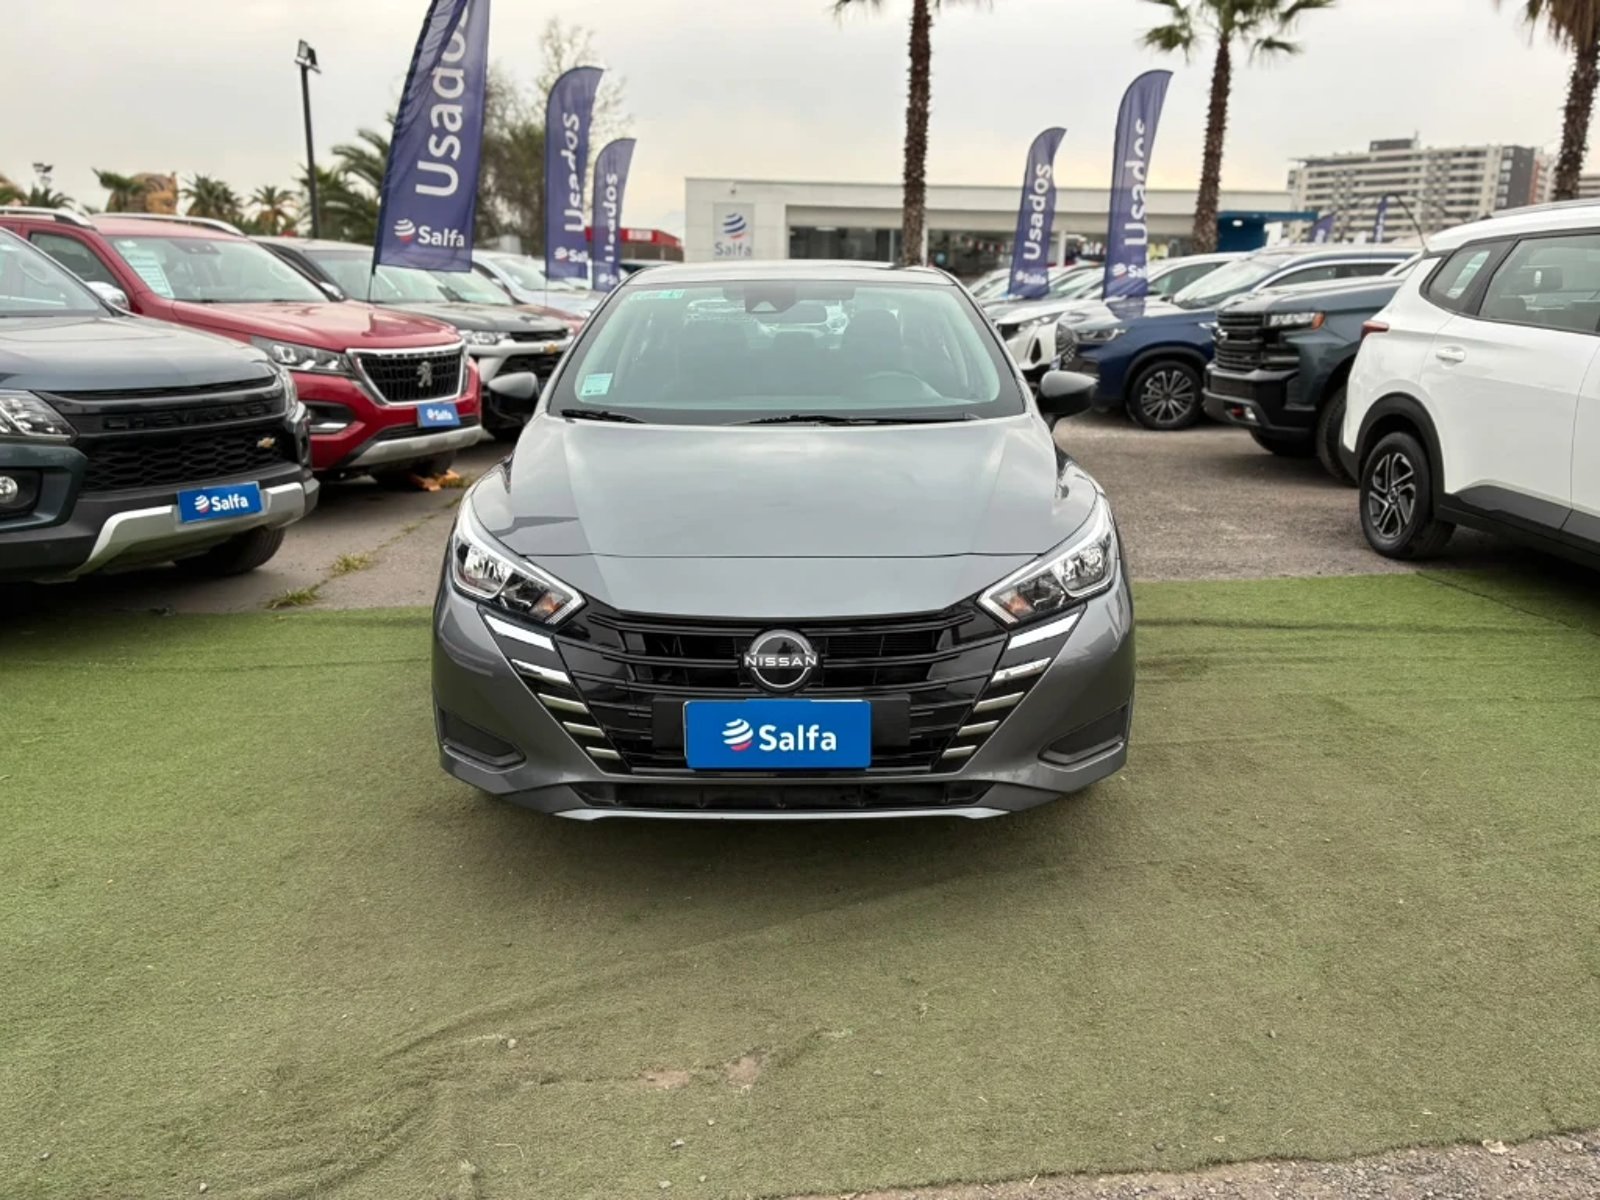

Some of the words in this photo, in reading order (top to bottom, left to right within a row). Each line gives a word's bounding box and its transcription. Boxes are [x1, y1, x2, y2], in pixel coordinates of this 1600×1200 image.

[1023, 163, 1051, 260] Usados
[418, 226, 465, 248] Salfa
[714, 241, 752, 257] Salfa
[210, 493, 249, 512] Salfa
[744, 655, 818, 667] NISSAN
[758, 724, 837, 751] Salfa
